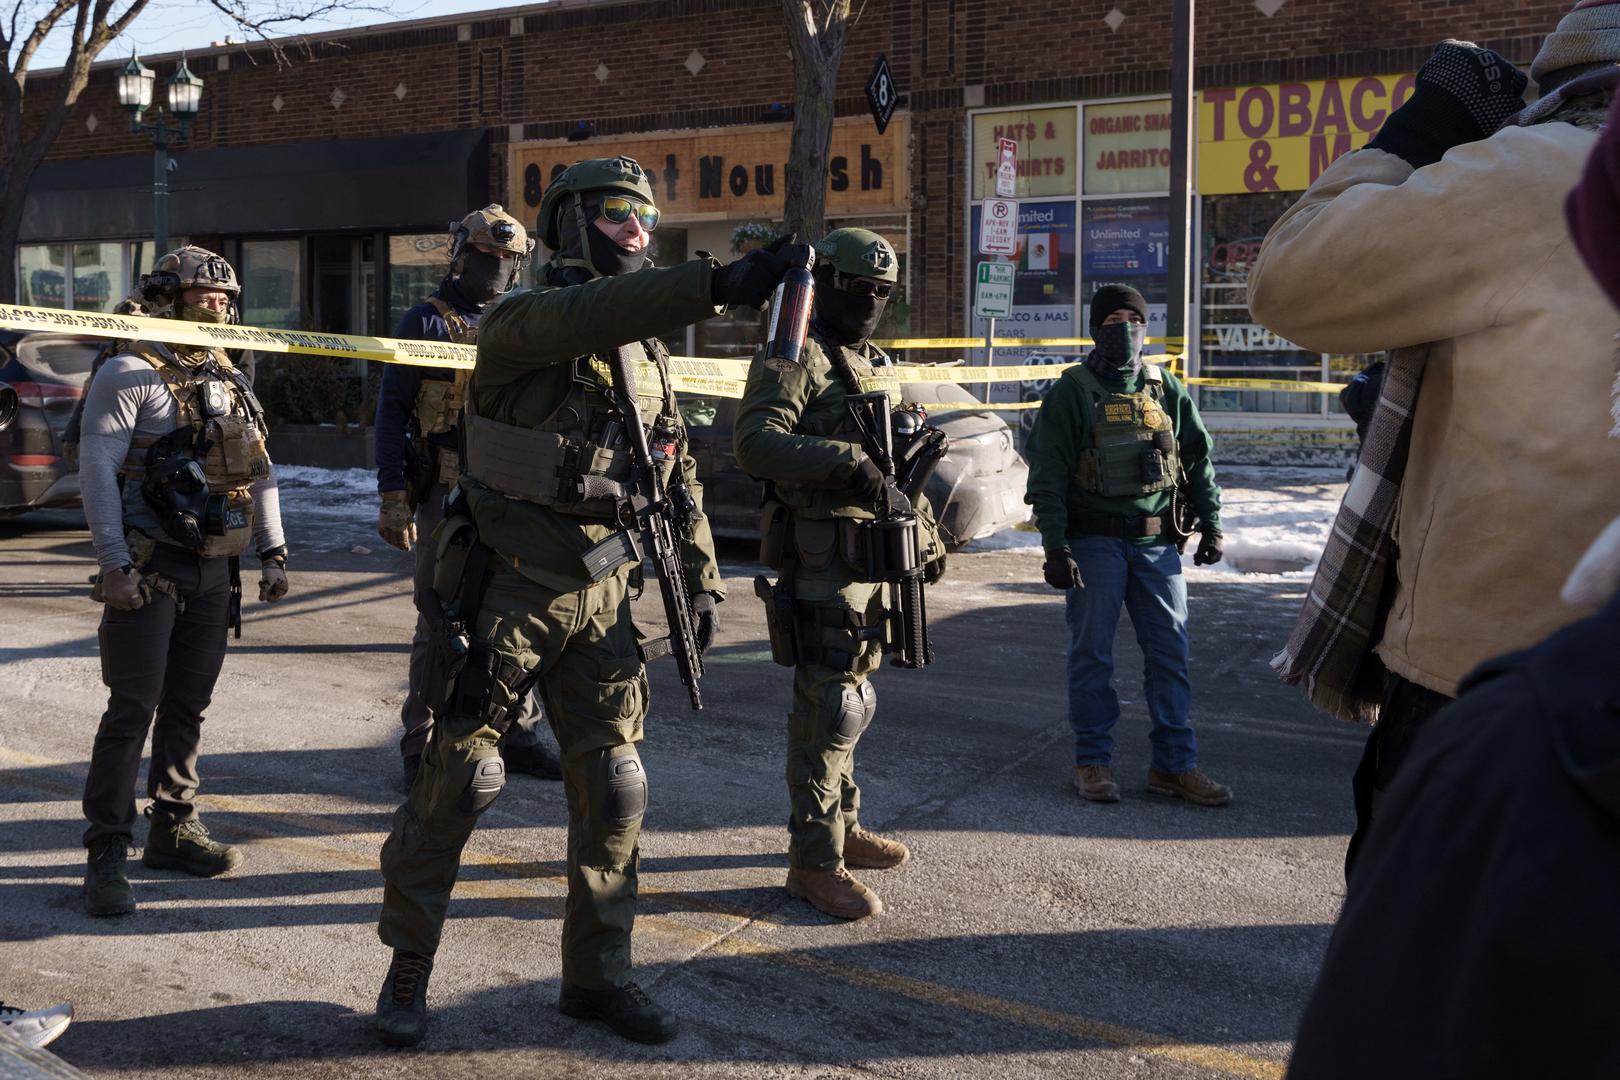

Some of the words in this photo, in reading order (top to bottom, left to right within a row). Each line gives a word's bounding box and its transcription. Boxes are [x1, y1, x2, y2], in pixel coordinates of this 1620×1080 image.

[993, 122, 1037, 143] HATS
[1044, 121, 1056, 140] &
[1089, 114, 1141, 136] ORGANIC
[699, 143, 883, 199] Noush
[1243, 140, 1281, 192] &
[1090, 228, 1141, 240] Unlimited
[1043, 310, 1069, 322] MAS
[994, 328, 1026, 338] IGARS
